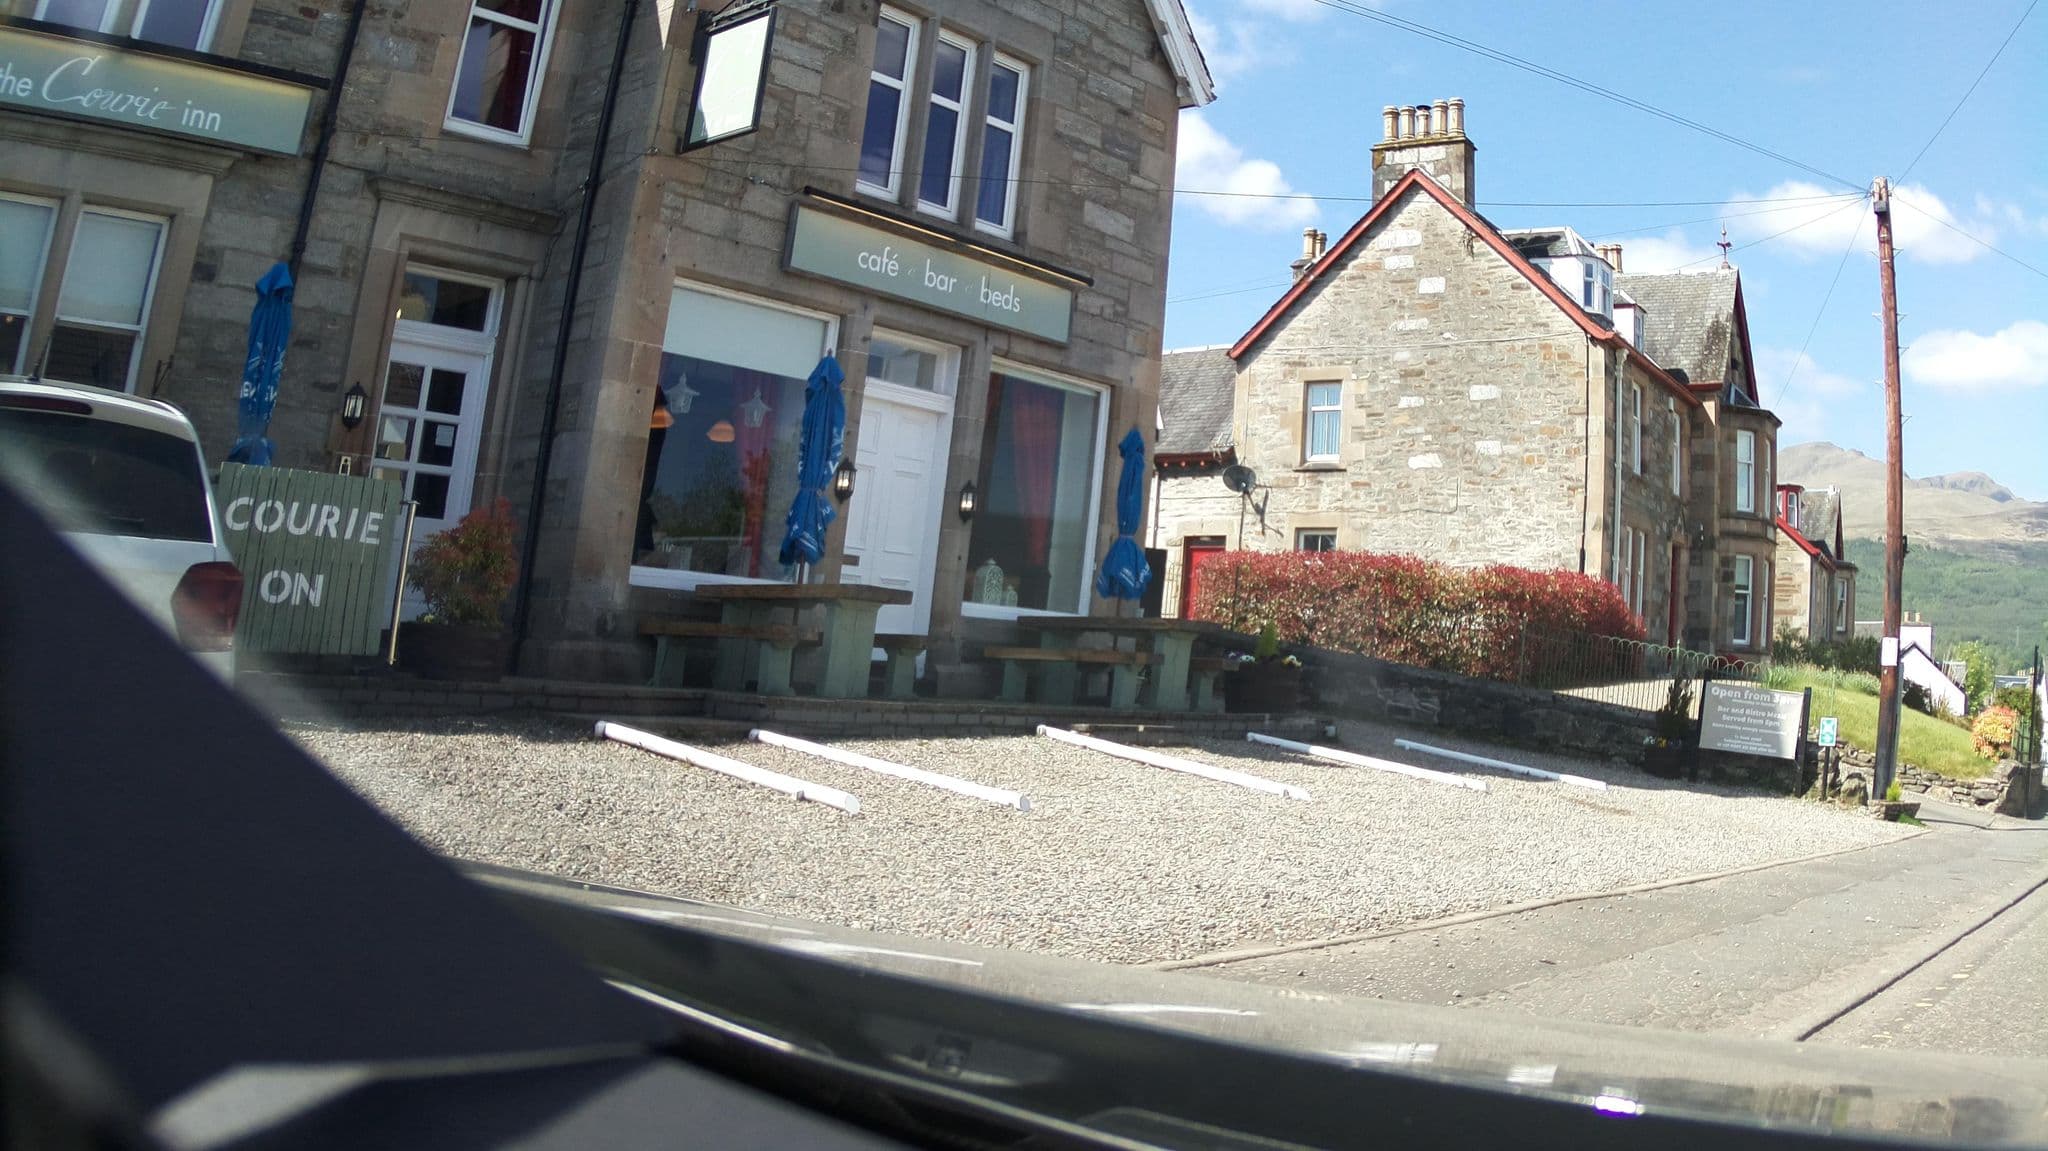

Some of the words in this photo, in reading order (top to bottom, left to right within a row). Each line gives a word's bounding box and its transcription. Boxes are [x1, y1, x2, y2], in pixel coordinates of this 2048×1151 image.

[42, 56, 176, 119] Courie
[181, 100, 221, 132] inn
[858, 246, 899, 277] café
[924, 258, 957, 293] bar
[980, 276, 1021, 313] beds
[225, 496, 384, 545] COURIE
[260, 569, 324, 607] ON
[1711, 686, 1741, 699] Open
[1743, 690, 1771, 702] from
